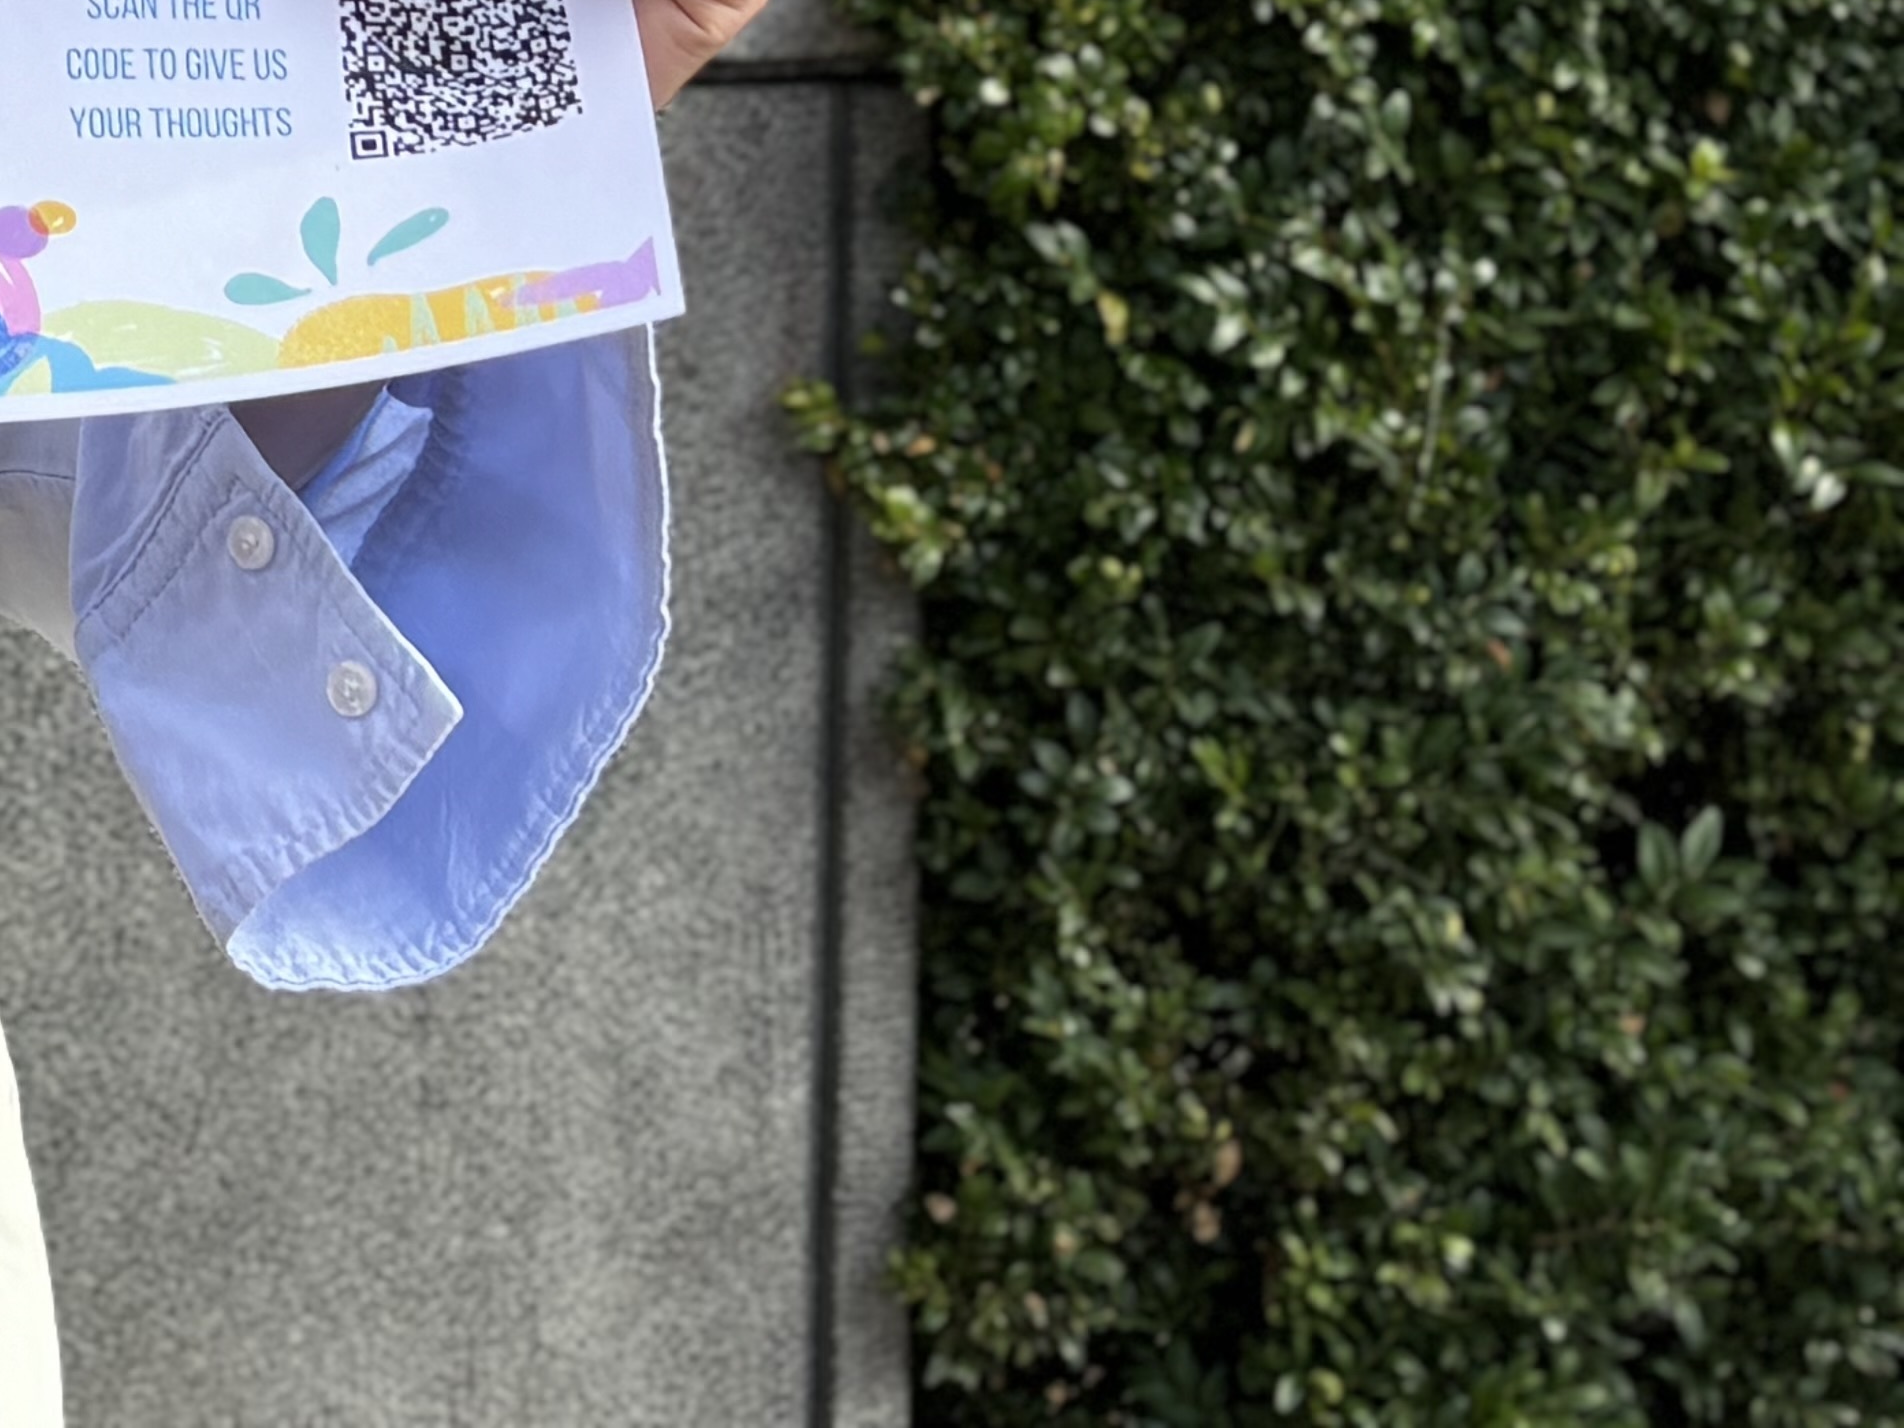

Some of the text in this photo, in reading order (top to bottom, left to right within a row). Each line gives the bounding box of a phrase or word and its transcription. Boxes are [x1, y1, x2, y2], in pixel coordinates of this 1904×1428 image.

[66, 47, 288, 81] CODE TO GIVE US
[69, 107, 293, 139] YOUR THOUGHTS
